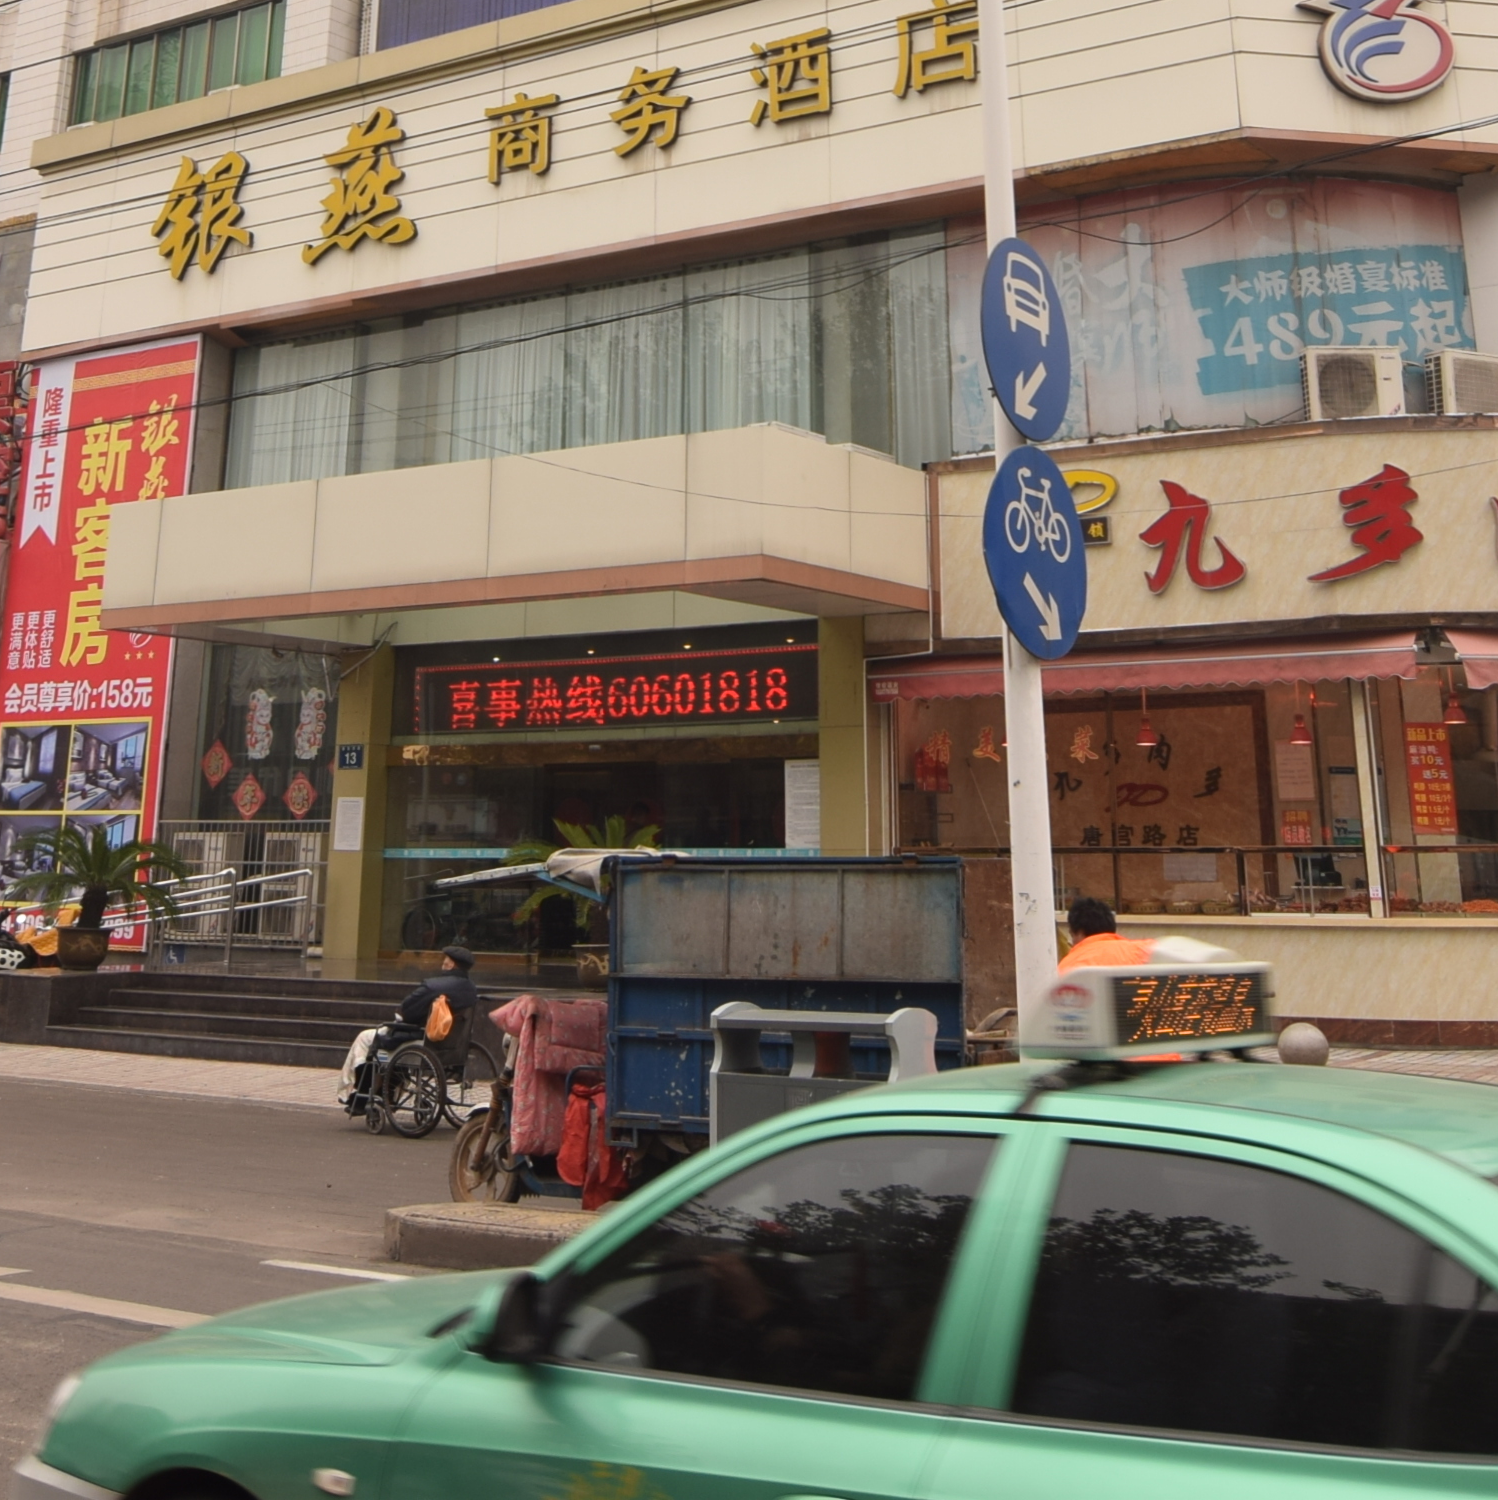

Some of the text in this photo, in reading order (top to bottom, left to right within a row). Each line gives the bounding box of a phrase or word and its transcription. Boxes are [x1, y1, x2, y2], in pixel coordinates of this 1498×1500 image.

[1219, 260, 1449, 306] 大师级婚宴标准
[32, 386, 65, 513] 隆重上市
[59, 414, 135, 669] 新客房
[4, 676, 154, 714] 会员尊享价:158元
[449, 667, 788, 730] 喜事热线60601818
[925, 724, 1099, 765] 精美菜
[1407, 728, 1446, 742] 新品上市
[344, 751, 358, 764] 13
[1411, 755, 1444, 766] 买10元
